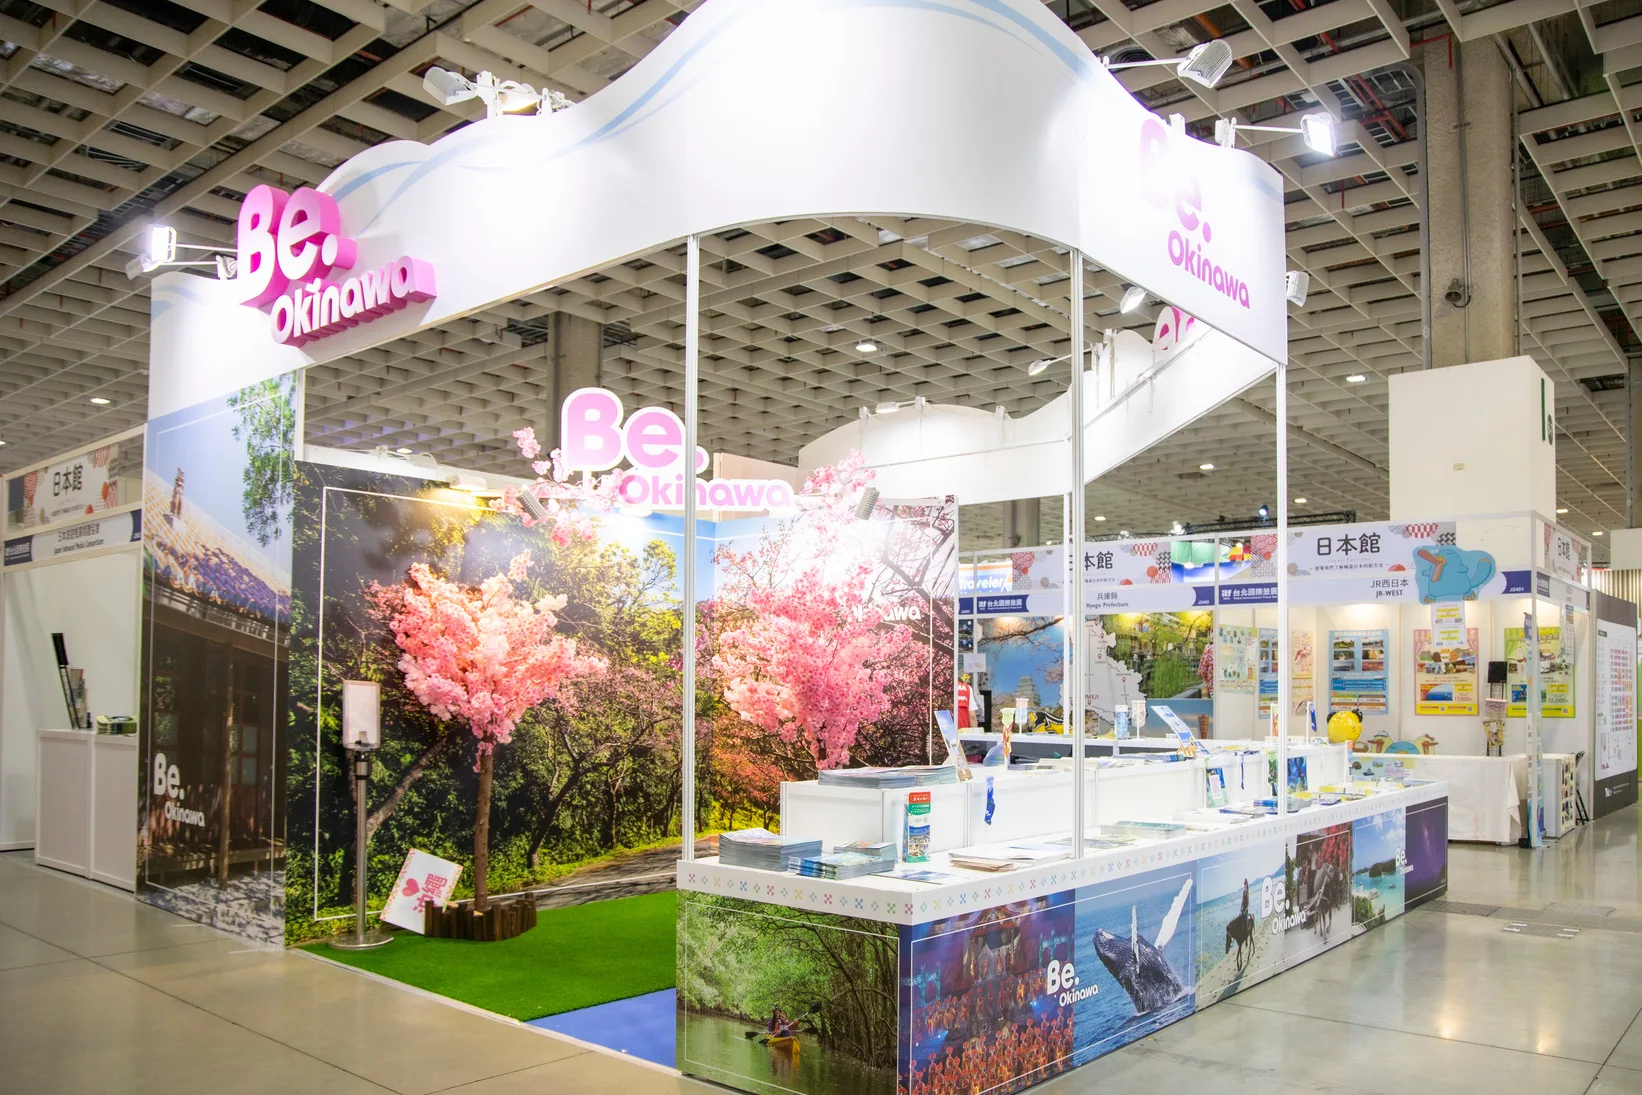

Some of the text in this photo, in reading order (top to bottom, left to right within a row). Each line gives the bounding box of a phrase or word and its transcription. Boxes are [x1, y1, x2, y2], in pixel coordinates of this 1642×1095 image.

[237, 184, 346, 305] Be.
[1168, 229, 1250, 309] Okinawa
[271, 256, 418, 344] Okinawa
[566, 392, 704, 469] Be.
[619, 473, 791, 507] Okinawa
[1317, 533, 1381, 556] 日本館
[1370, 578, 1409, 588] JR西日本
[1376, 589, 1403, 598] JR-WEST
[153, 752, 185, 800] Be.
[164, 800, 206, 827] Okinawa
[1394, 847, 1407, 868] Be.
[1261, 876, 1290, 919] Be.
[1271, 909, 1308, 935] Okinawa
[1047, 959, 1080, 995] Be.
[1059, 984, 1099, 1007] Okinawa
